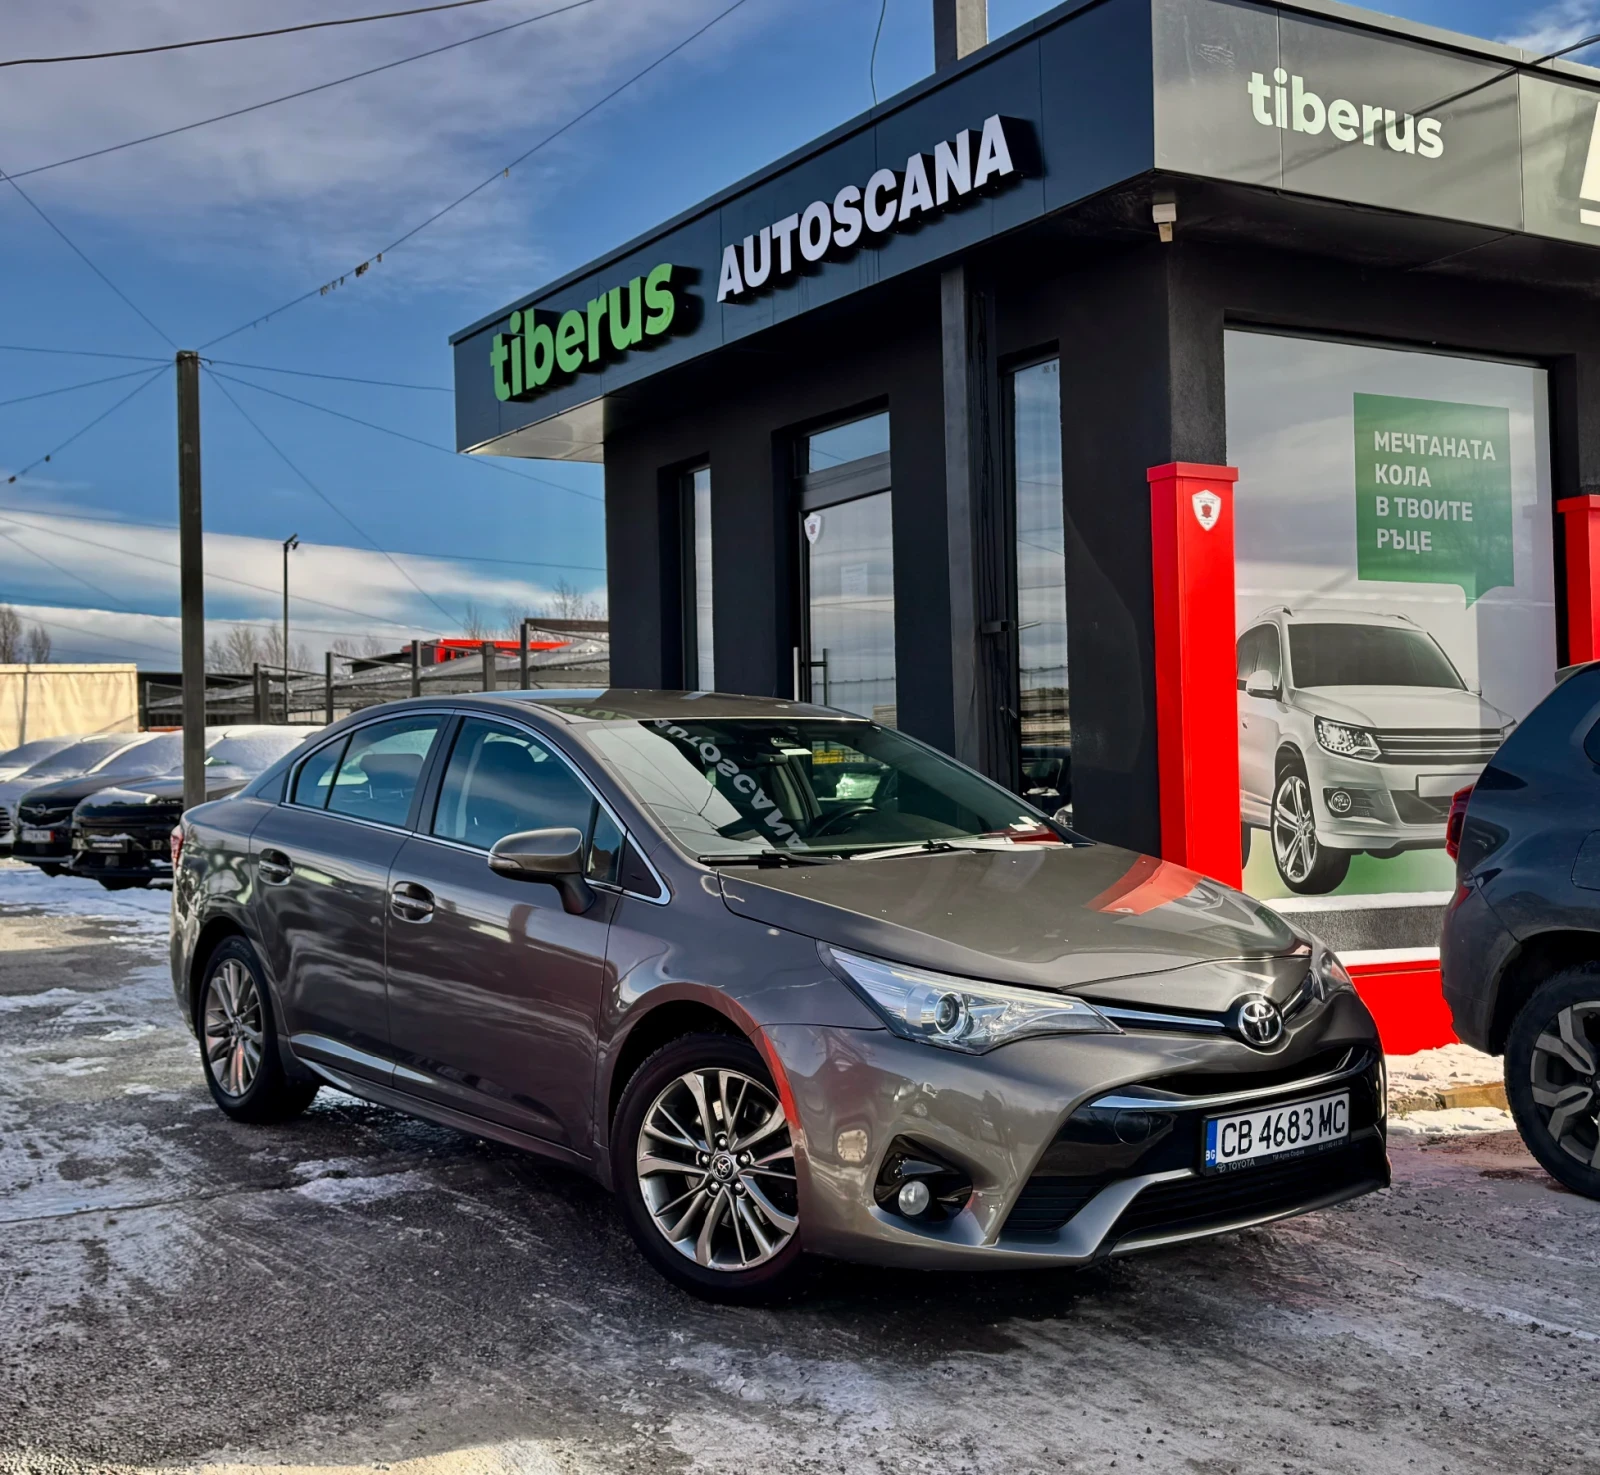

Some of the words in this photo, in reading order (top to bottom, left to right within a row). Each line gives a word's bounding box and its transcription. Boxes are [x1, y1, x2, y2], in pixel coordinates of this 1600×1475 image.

[1248, 67, 1444, 159] tiberus
[490, 263, 675, 402] tiberus
[716, 114, 1014, 303] AUTOSCANA
[1374, 430, 1497, 462] МЕЧТАНАТА
[1374, 463, 1432, 488] КОЛА
[1375, 495, 1390, 517] В
[1393, 497, 1474, 522] ТВОИТЕ
[1376, 528, 1433, 554] РЪЦЕ
[1221, 1119, 1253, 1158] CB
[1258, 1108, 1314, 1150] 4683
[1318, 1100, 1346, 1139] MC
[1206, 1149, 1216, 1161] BG
[1228, 1158, 1256, 1171] TOYOTA
